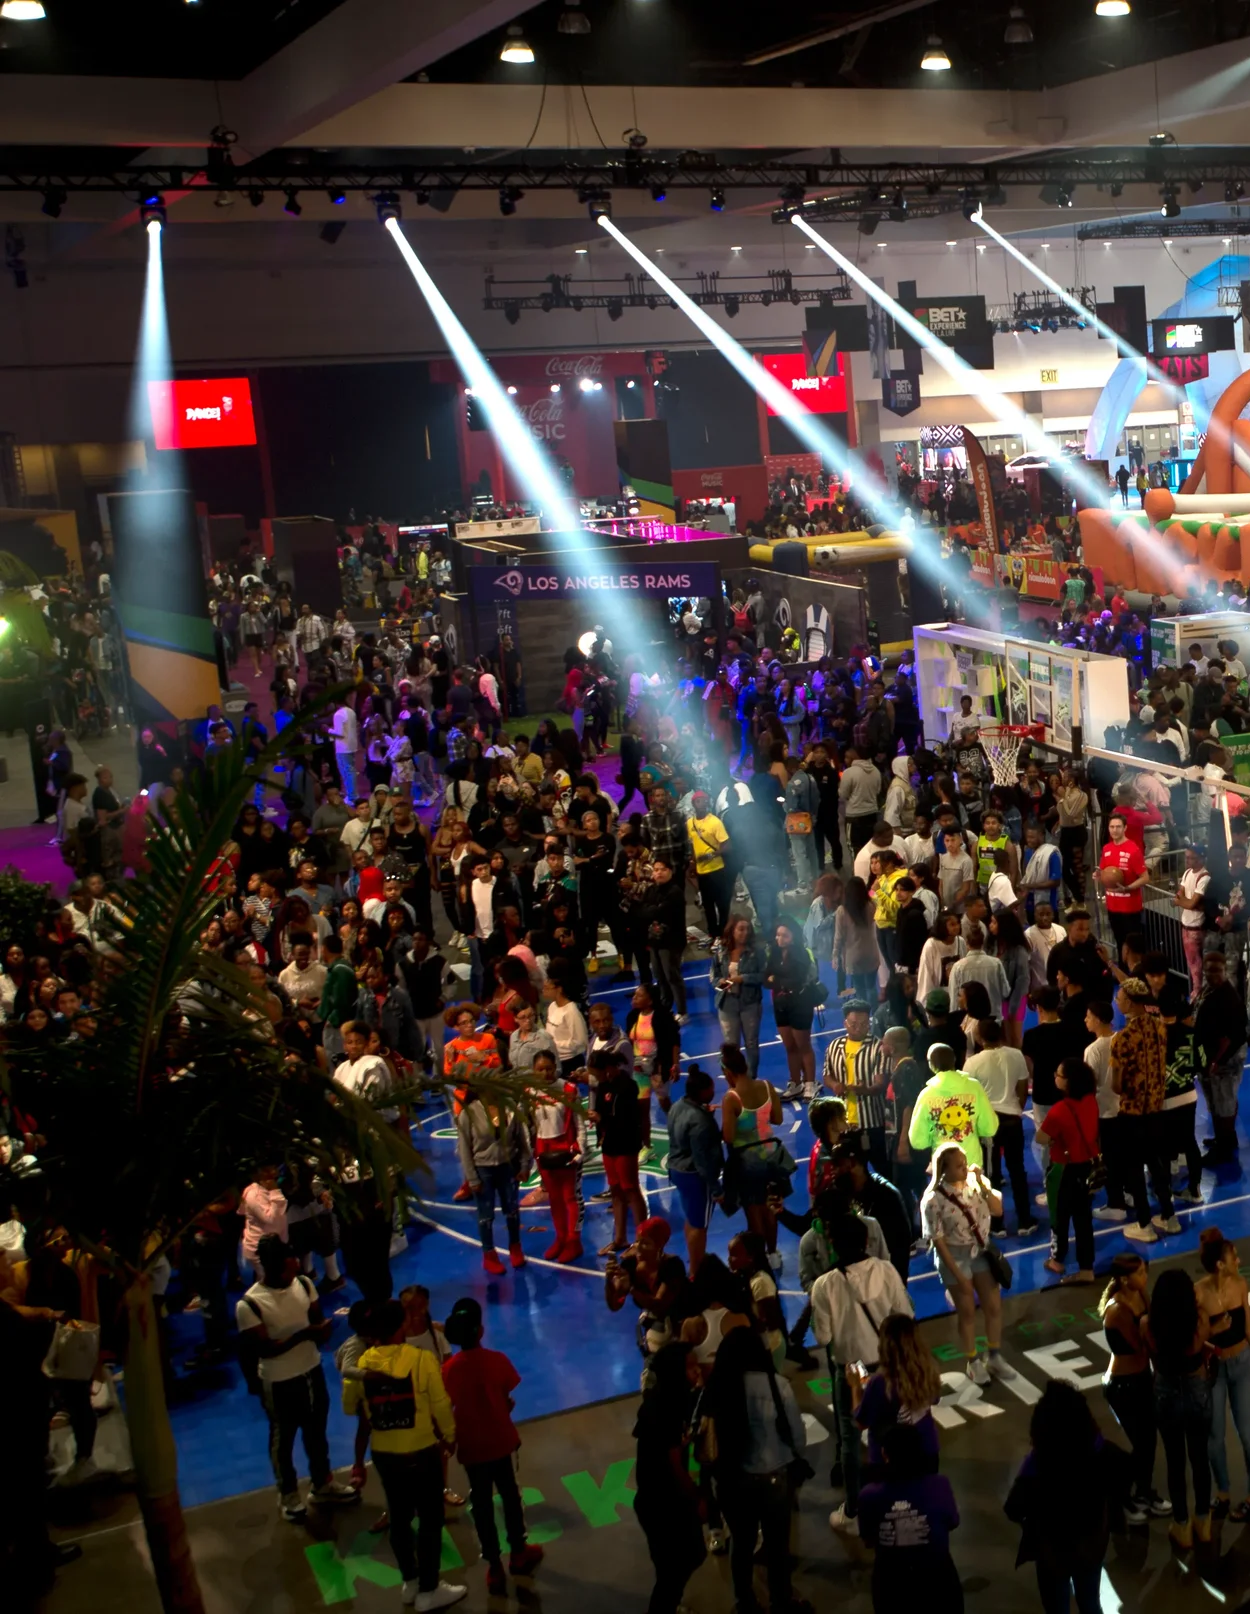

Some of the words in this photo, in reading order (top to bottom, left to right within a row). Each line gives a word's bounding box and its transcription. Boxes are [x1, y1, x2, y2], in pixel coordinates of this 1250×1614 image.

[928, 307, 960, 322] BET
[930, 321, 967, 331] EXPERIENCE
[1040, 369, 1058, 382] EXIT
[895, 379, 909, 394] BET
[532, 423, 567, 440] SIC
[528, 576, 559, 591] LOS
[564, 575, 640, 590] ANGELES
[645, 574, 692, 589] RAMS
